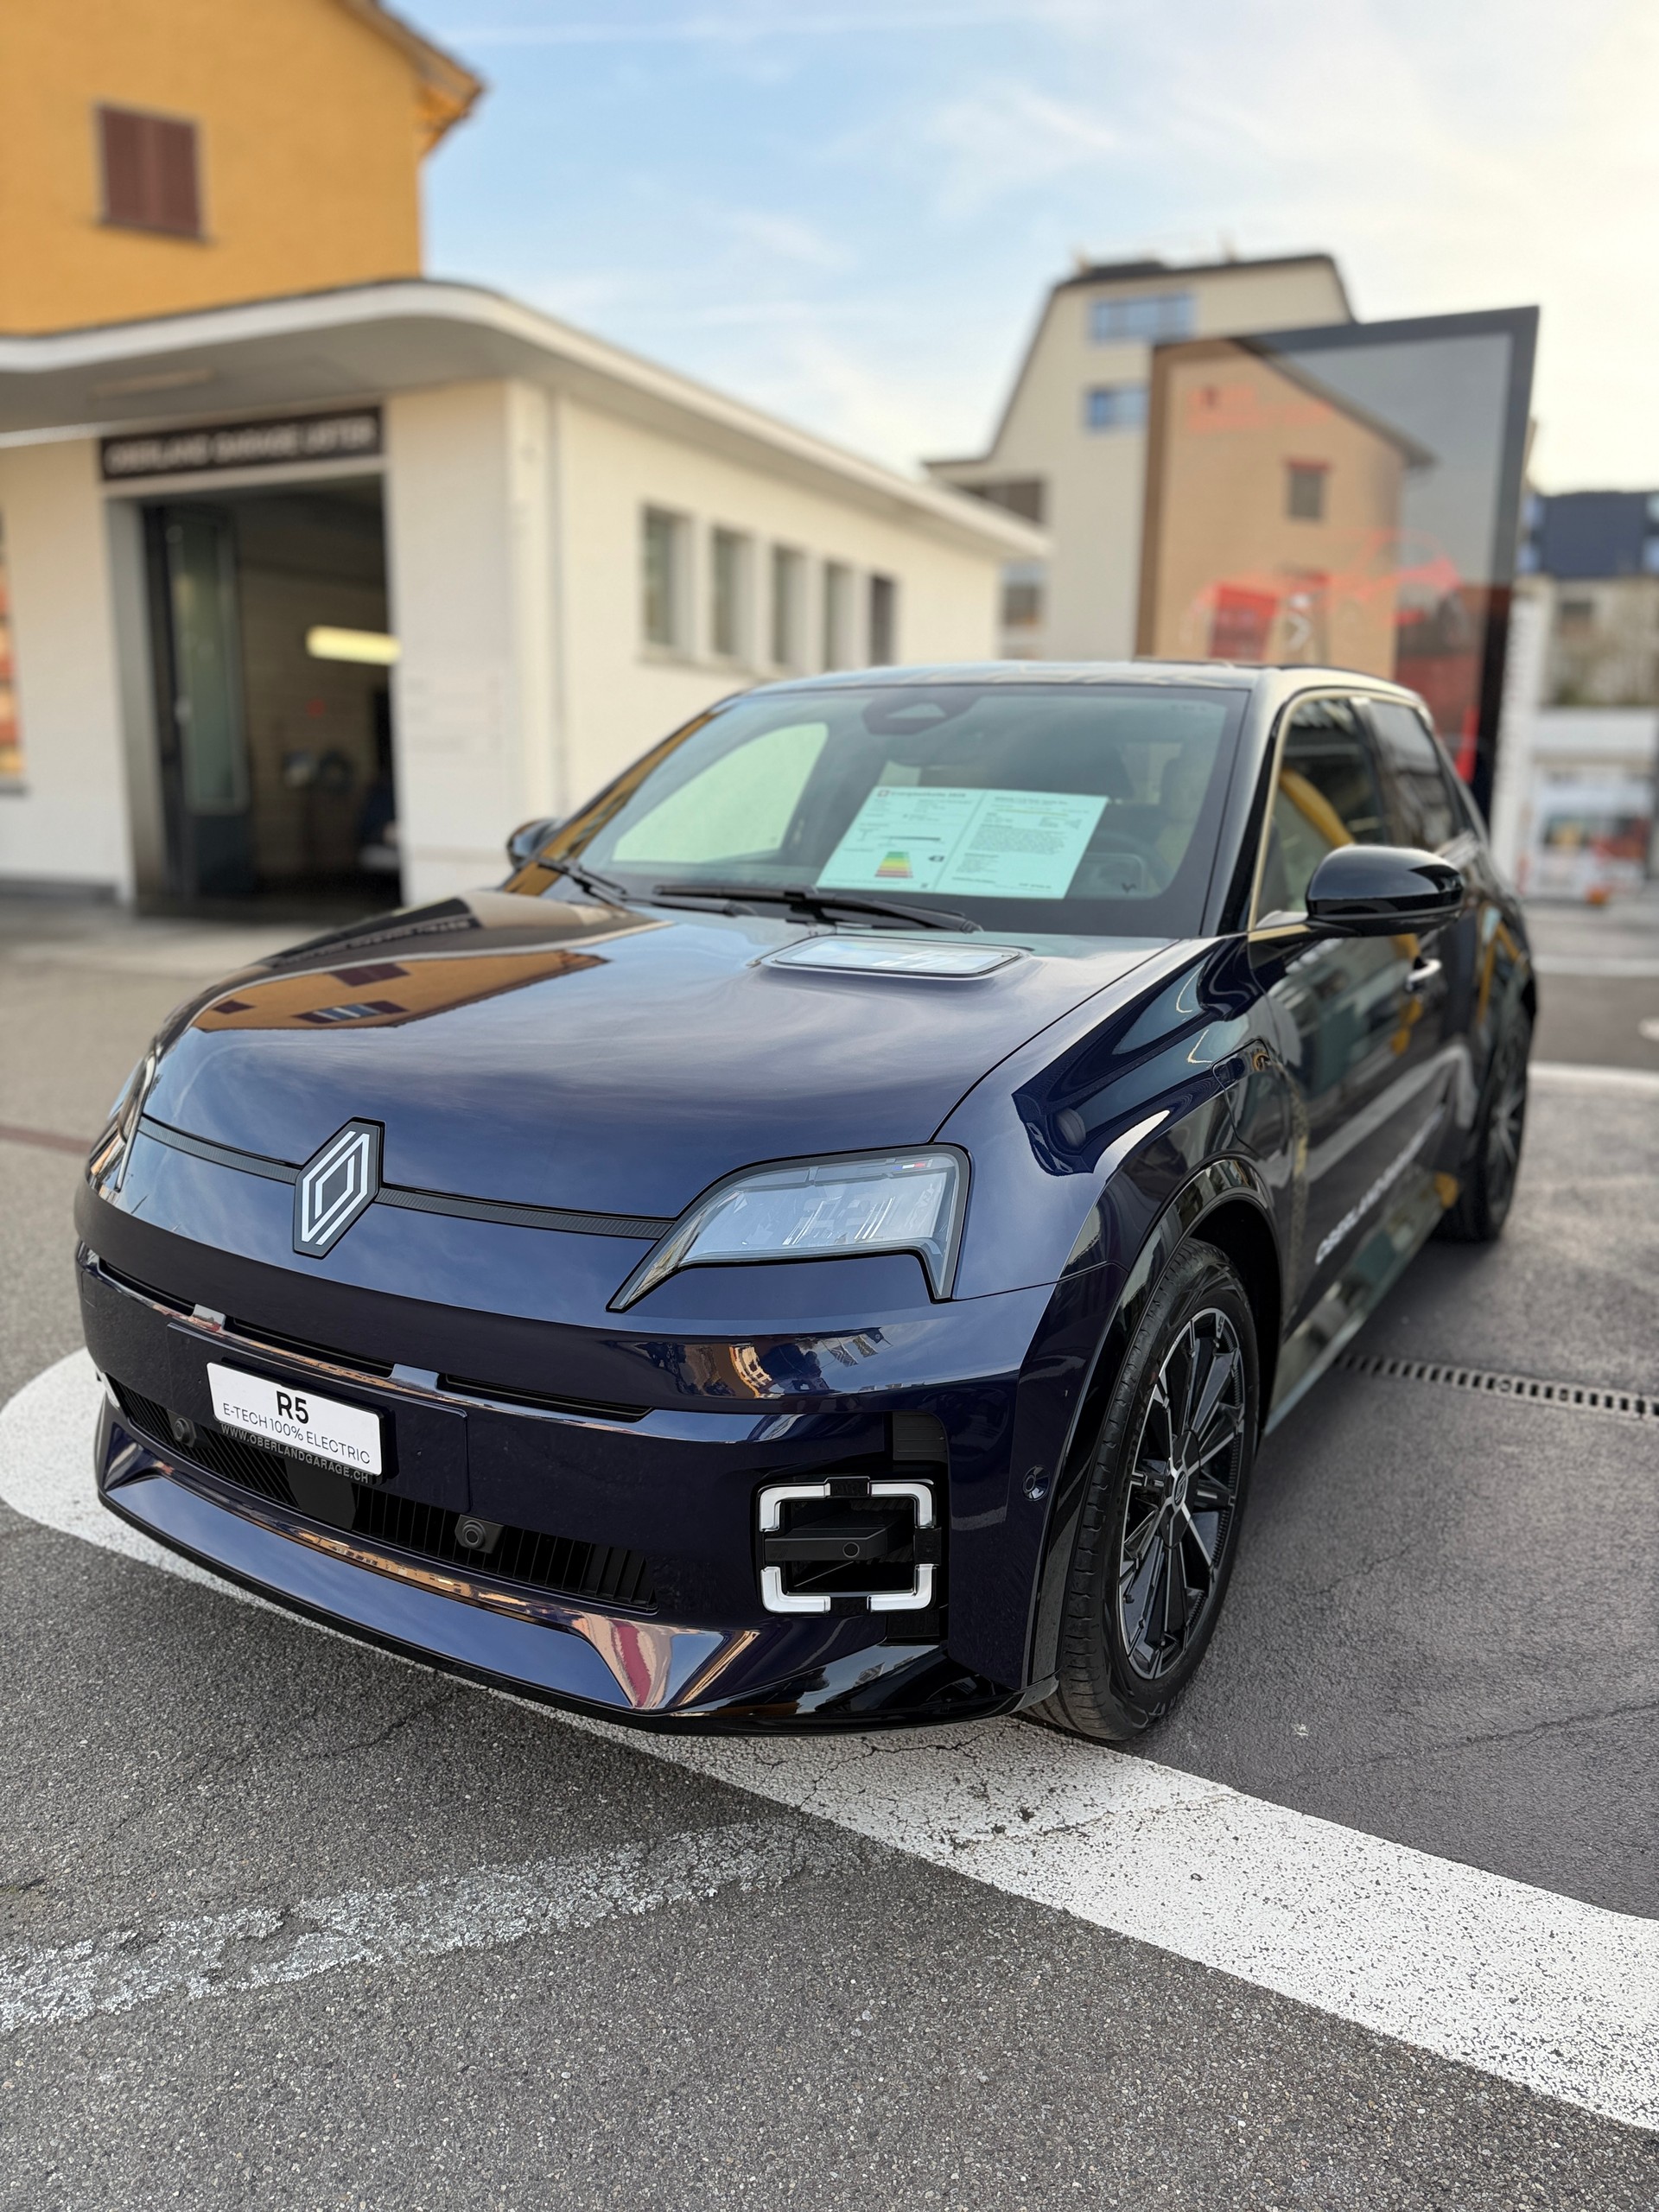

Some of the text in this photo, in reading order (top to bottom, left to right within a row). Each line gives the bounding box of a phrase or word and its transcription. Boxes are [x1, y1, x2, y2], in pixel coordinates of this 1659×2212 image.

[223, 1402, 371, 1465] E-TECH 100% ELECTRIC
[276, 1389, 310, 1425] R5
[220, 1424, 369, 1484] WWW.OBERLANDGARAGE.CH
